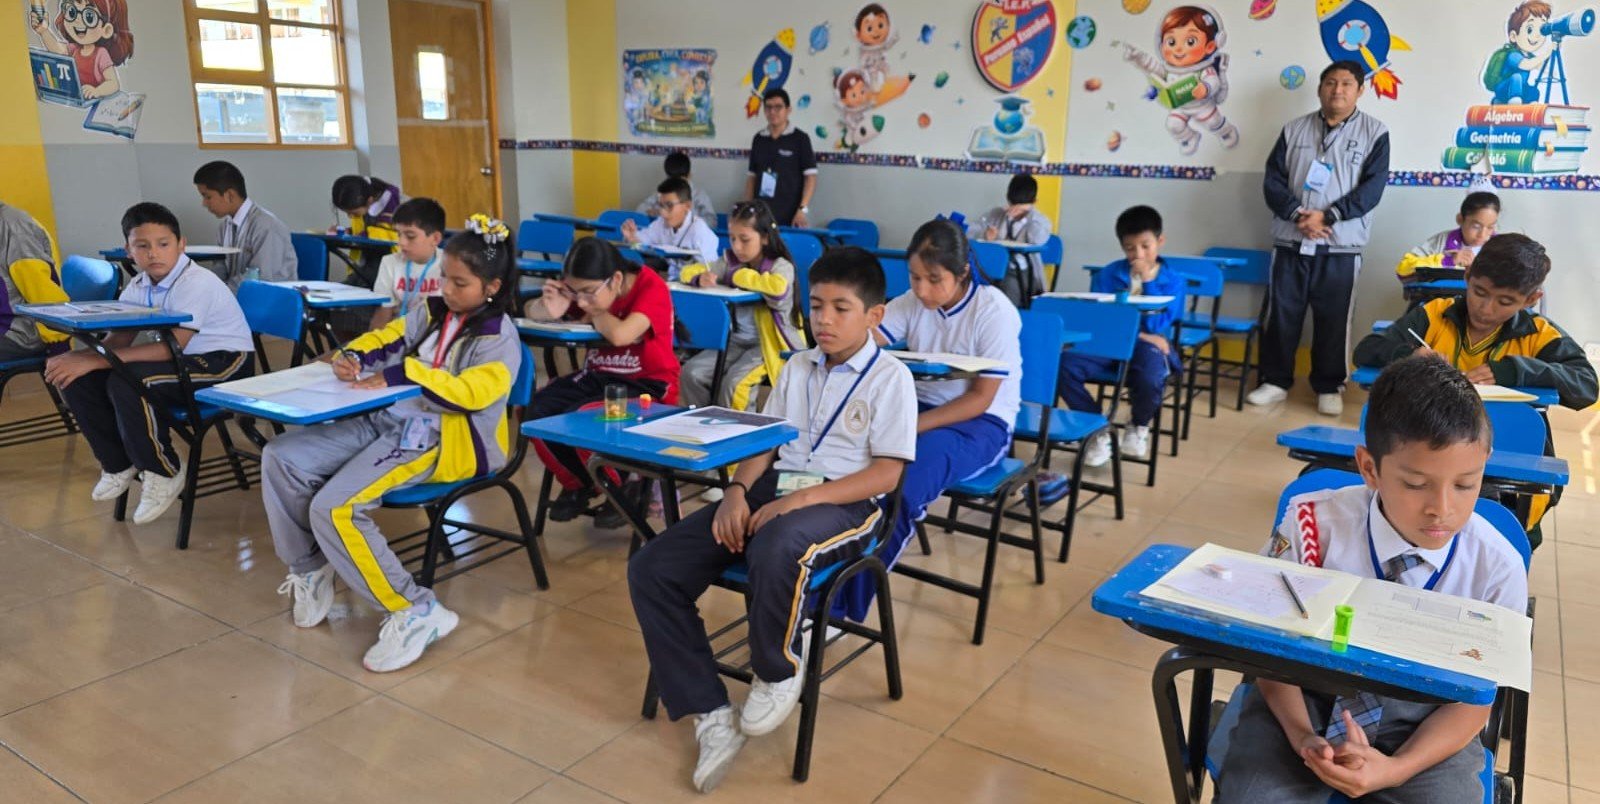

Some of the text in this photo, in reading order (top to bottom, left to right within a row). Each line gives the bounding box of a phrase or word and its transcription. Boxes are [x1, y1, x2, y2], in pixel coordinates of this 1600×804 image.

[1470, 131, 1522, 144] Geometría
[1345, 140, 1358, 151] P
[1351, 151, 1362, 164] E
